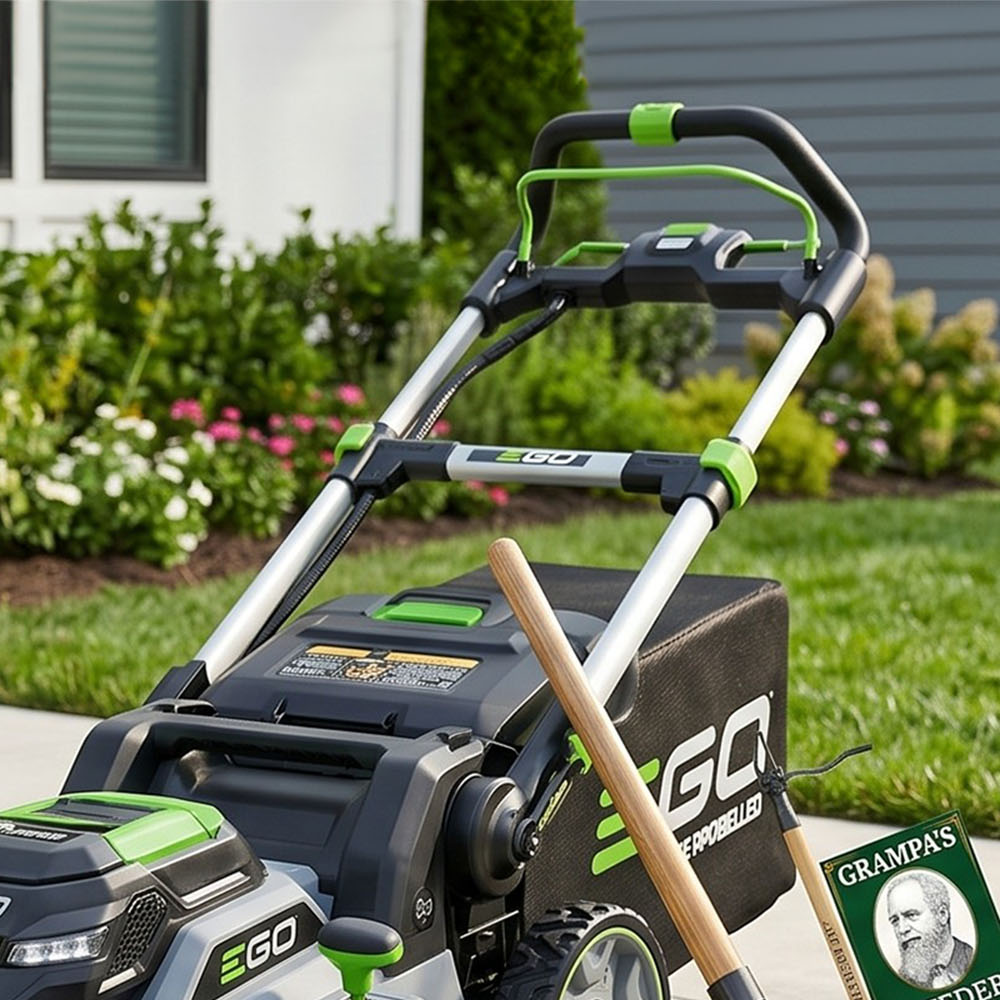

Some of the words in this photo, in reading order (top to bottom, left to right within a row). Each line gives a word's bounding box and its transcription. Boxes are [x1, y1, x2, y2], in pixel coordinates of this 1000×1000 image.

[496, 448, 578, 465] EGO
[837, 825, 957, 887] GRAMPA'S
[221, 916, 297, 985] EGO
